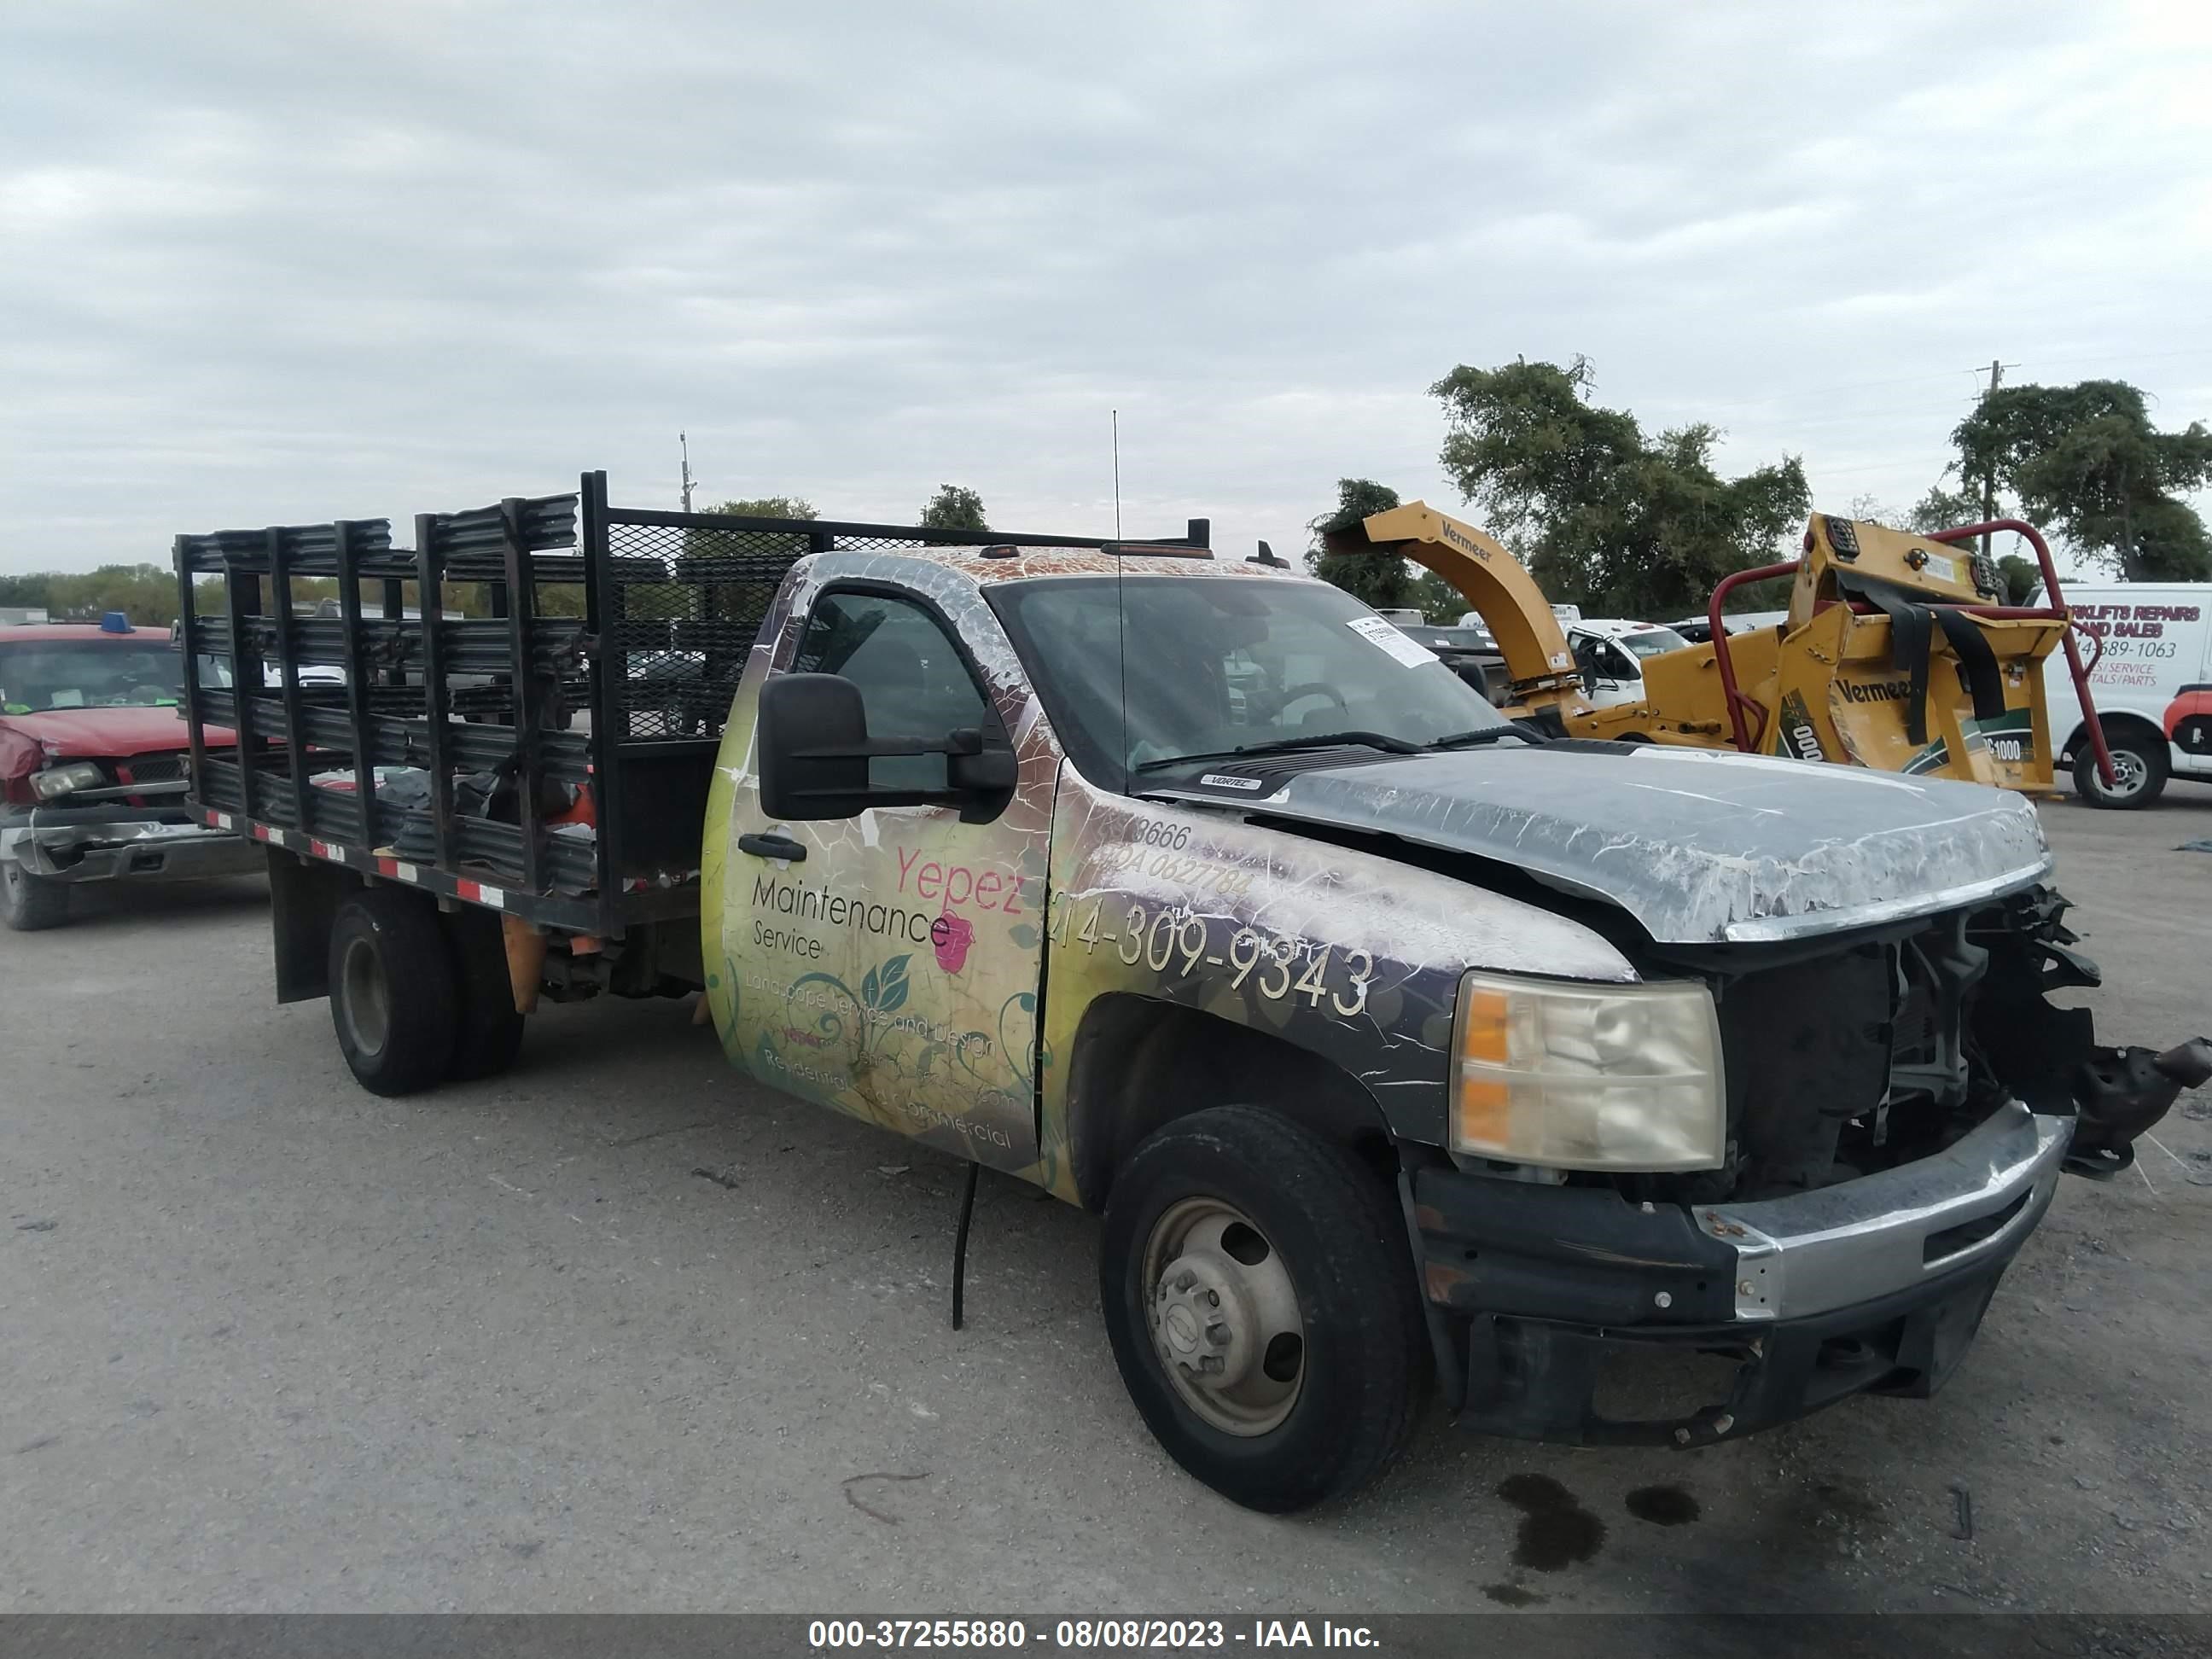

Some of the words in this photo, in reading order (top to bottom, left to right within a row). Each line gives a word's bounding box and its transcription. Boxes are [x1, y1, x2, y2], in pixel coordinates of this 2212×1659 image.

[1442, 519, 1492, 562] Vermeer
[2066, 605, 2131, 620] RKLIFTS
[2133, 606, 2200, 621] REPAIRS
[2114, 623, 2164, 638] SALES
[2063, 641, 2177, 658] 14-689-1063
[1835, 679, 1912, 703] Vermee
[1212, 777, 1252, 787] VORTEC
[898, 846, 1025, 914] Yepez
[1149, 854, 1254, 894] 0627784
[752, 874, 950, 946] Maintenance
[754, 920, 821, 959] Service
[894, 1015, 928, 1039] and
[934, 1022, 997, 1058] Design
